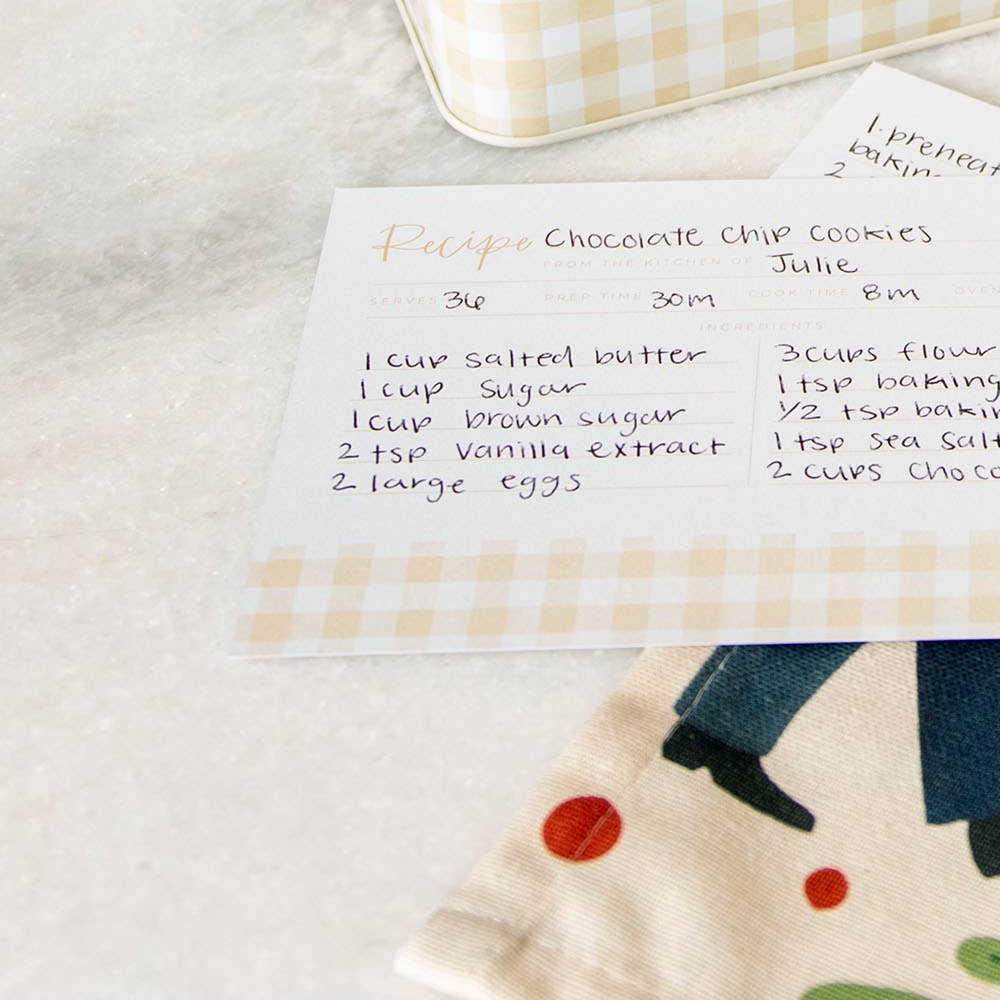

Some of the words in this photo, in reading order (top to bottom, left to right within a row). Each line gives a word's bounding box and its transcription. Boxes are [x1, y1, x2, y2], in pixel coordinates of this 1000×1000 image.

[848, 138, 942, 178] bakin
[372, 223, 536, 271] Recipe
[768, 252, 859, 275] Julie
[442, 291, 486, 312] 36
[387, 352, 449, 370] cup
[594, 345, 708, 366] butter
[898, 341, 998, 360] flour
[382, 381, 445, 404] cup
[797, 374, 853, 394] tsp
[368, 412, 433, 434] cup
[465, 409, 563, 429] brown
[576, 406, 687, 437] sugar
[842, 402, 900, 422] tsp
[337, 442, 360, 460] 2
[371, 443, 427, 464] tsp
[586, 438, 727, 457] extract
[797, 432, 845, 455] tsp
[766, 459, 792, 479] 2
[804, 462, 882, 482] cups
[331, 472, 358, 492] 2
[371, 473, 467, 503] large
[500, 471, 582, 500] eggs
